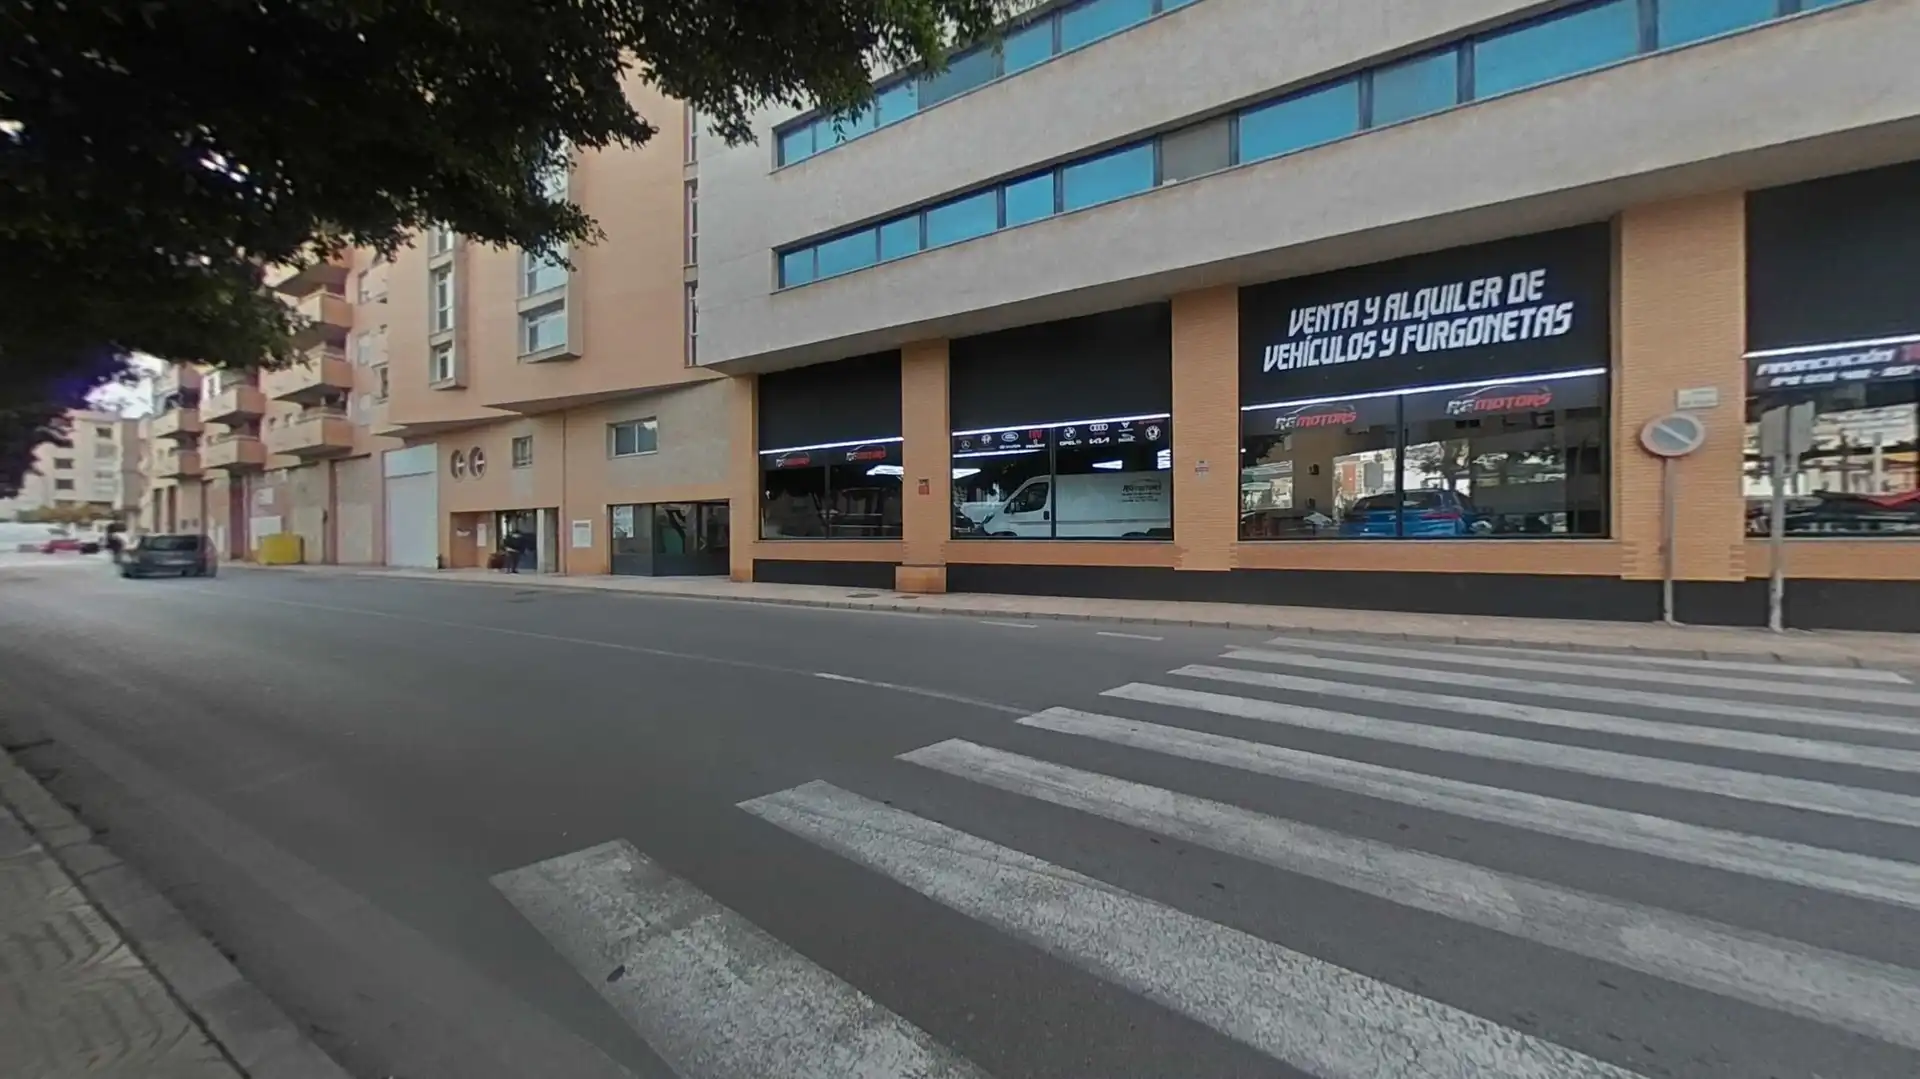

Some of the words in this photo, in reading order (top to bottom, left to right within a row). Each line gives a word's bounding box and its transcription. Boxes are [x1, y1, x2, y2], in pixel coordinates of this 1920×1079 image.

[1263, 331, 1377, 372] VEHÍCULOS
[1378, 327, 1398, 357] Y
[1401, 301, 1574, 354] FURGONETAS
[1288, 300, 1359, 337] VENTA
[1363, 295, 1381, 326] Y
[1383, 276, 1503, 323] ALQUILER
[1507, 268, 1546, 305] DE
